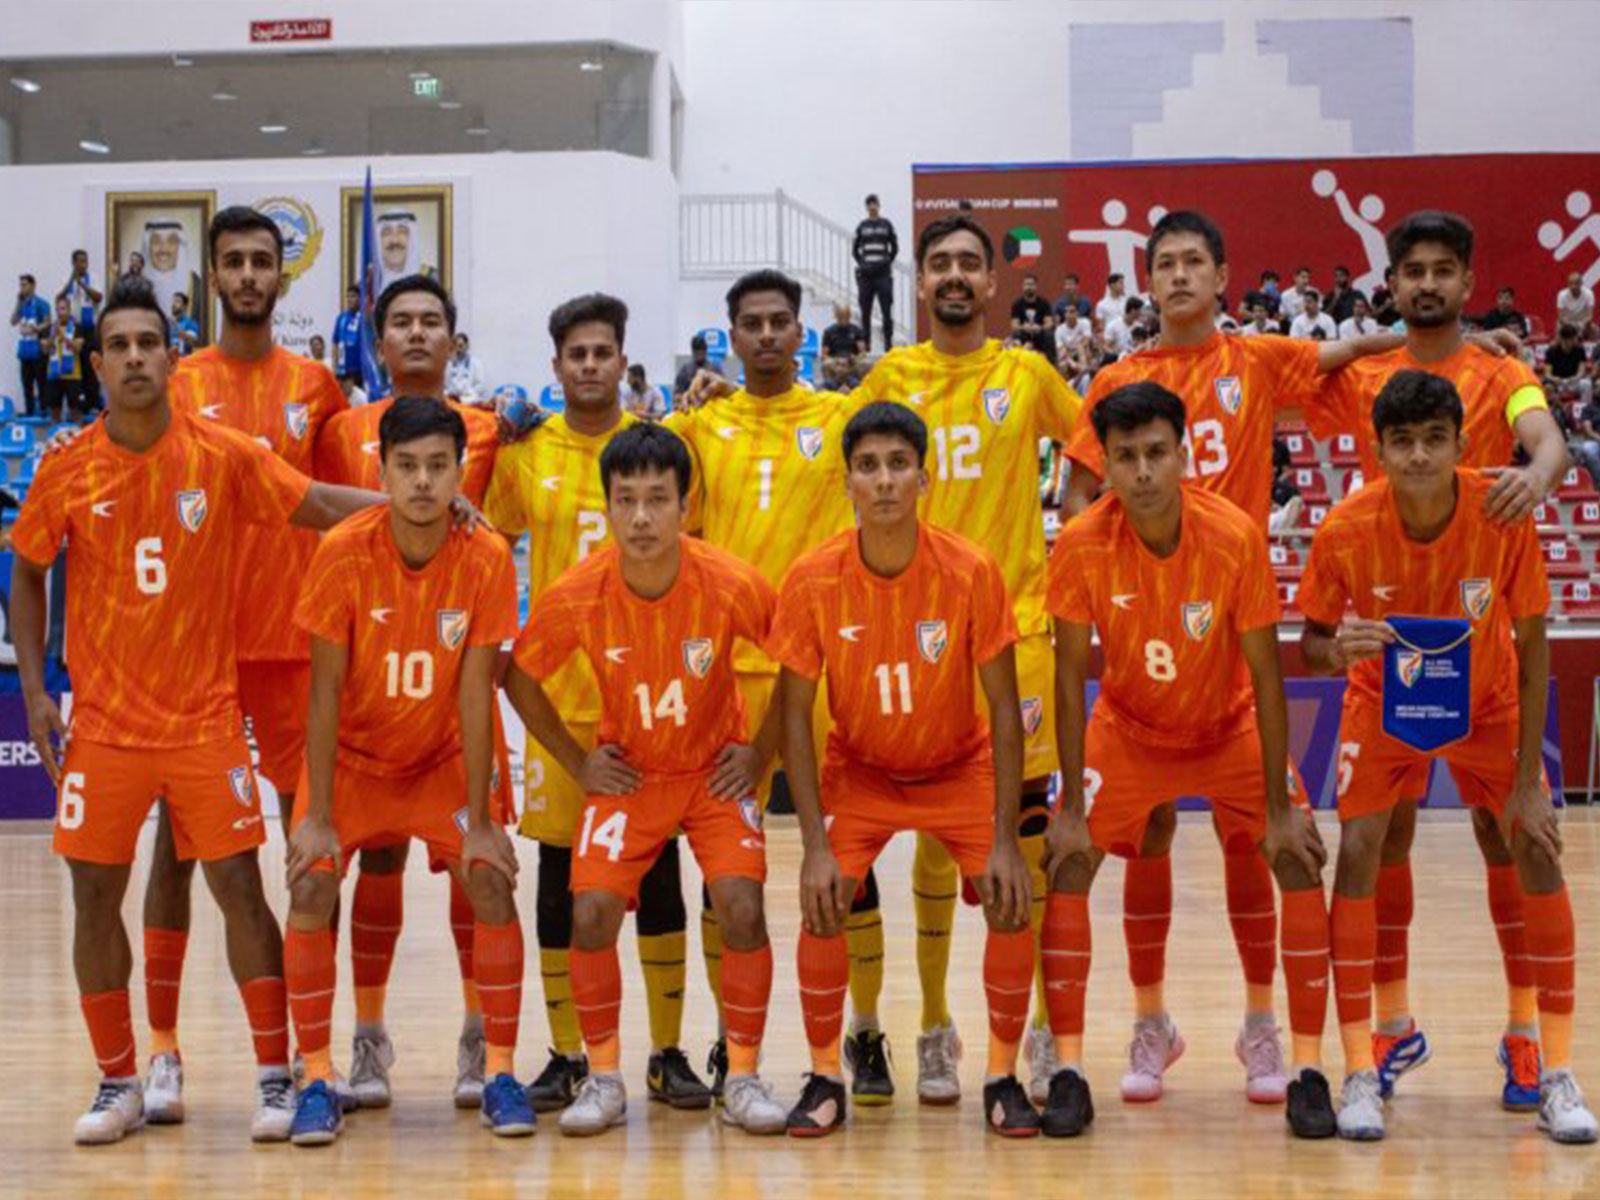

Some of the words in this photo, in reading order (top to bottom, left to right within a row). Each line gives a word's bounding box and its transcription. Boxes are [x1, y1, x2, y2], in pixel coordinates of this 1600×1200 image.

[933, 423, 981, 480] 12
[758, 458, 772, 511] 1
[134, 537, 167, 594] 6
[385, 651, 434, 699] 10
[1144, 639, 1177, 682] 8
[634, 679, 688, 730] 14
[874, 662, 913, 714] 11
[0, 741, 41, 766] ERS
[60, 772, 85, 830] 6
[577, 805, 628, 862] 14
